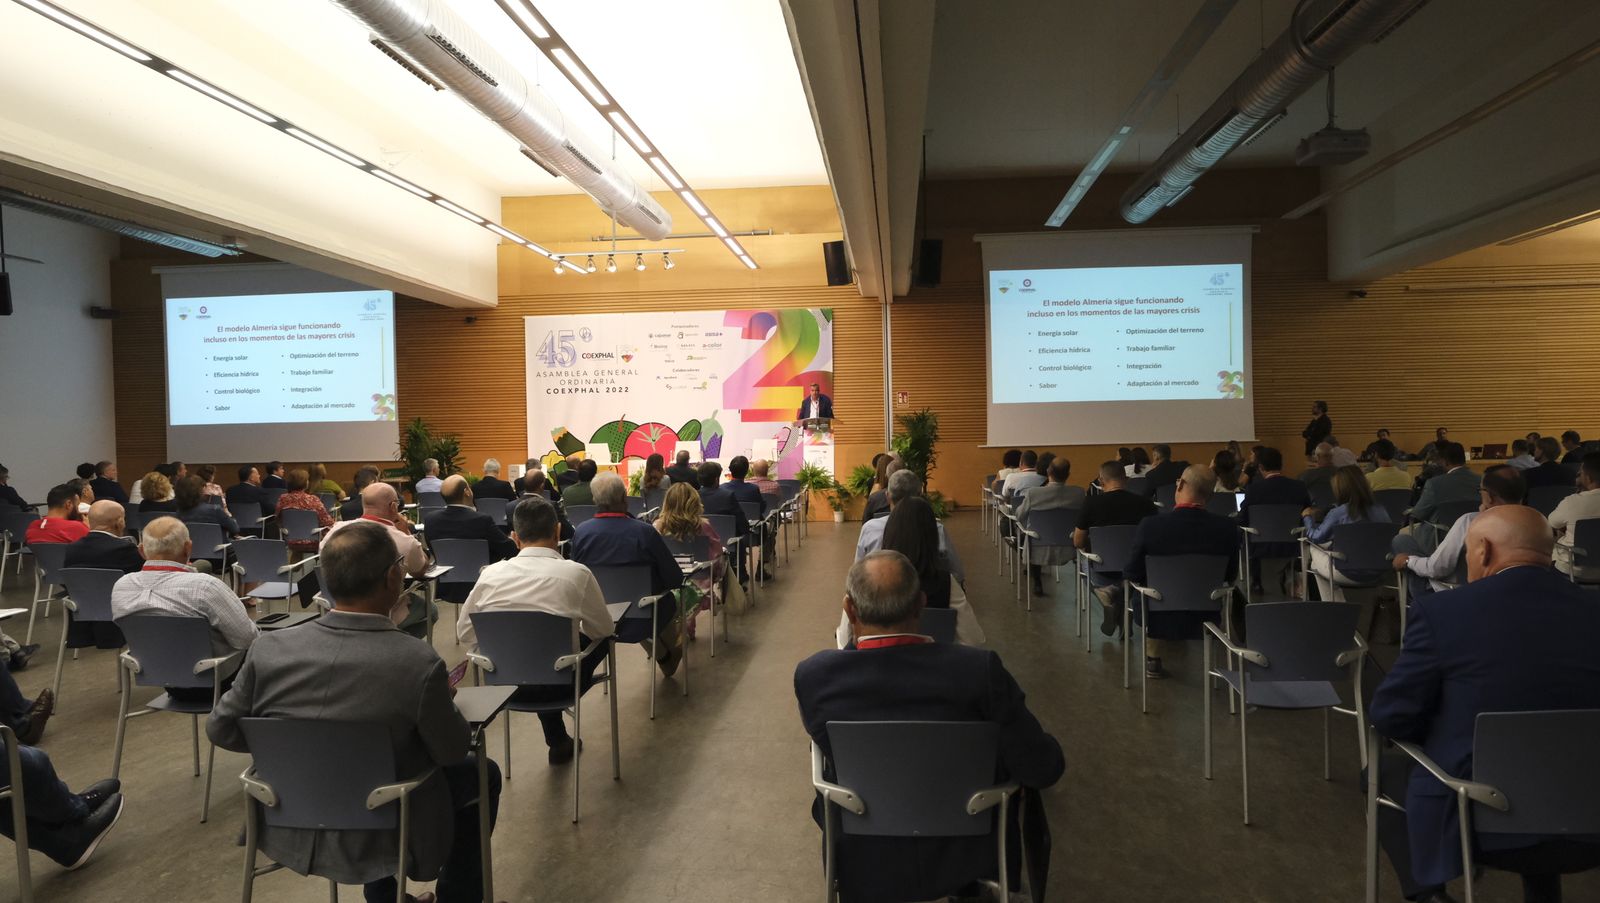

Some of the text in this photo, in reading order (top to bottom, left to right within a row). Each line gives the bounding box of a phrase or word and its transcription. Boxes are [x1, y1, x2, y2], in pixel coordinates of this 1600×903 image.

[1147, 308, 1179, 316] mayores
[1126, 328, 1167, 336] Optimización
[1063, 364, 1091, 372] biológico
[536, 370, 588, 378] ASAMBLEA
[1127, 380, 1163, 388] Adaptación
